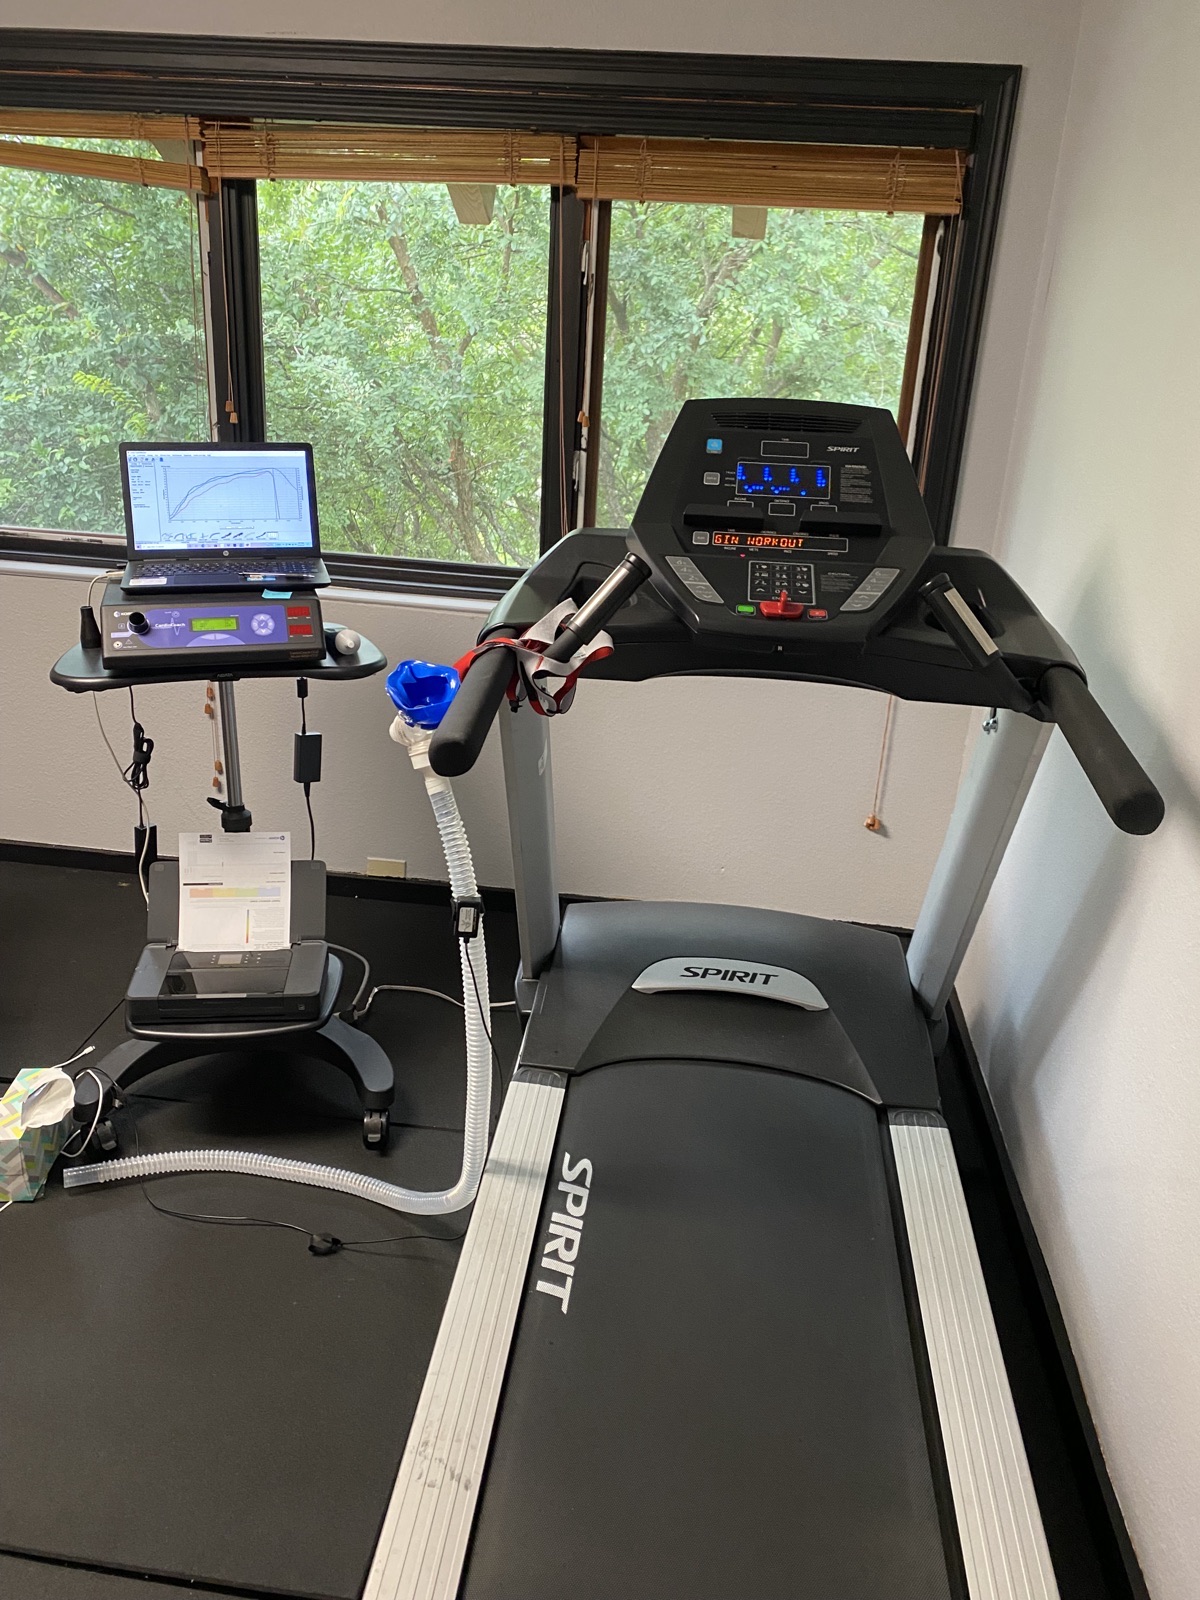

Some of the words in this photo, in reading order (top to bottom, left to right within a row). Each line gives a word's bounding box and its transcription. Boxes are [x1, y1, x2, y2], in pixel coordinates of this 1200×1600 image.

[826, 445, 860, 453] SPIRIT
[746, 536, 804, 548] WORKOUT
[679, 966, 779, 986] SPIRIT
[534, 1150, 594, 1316] SPIRIT
